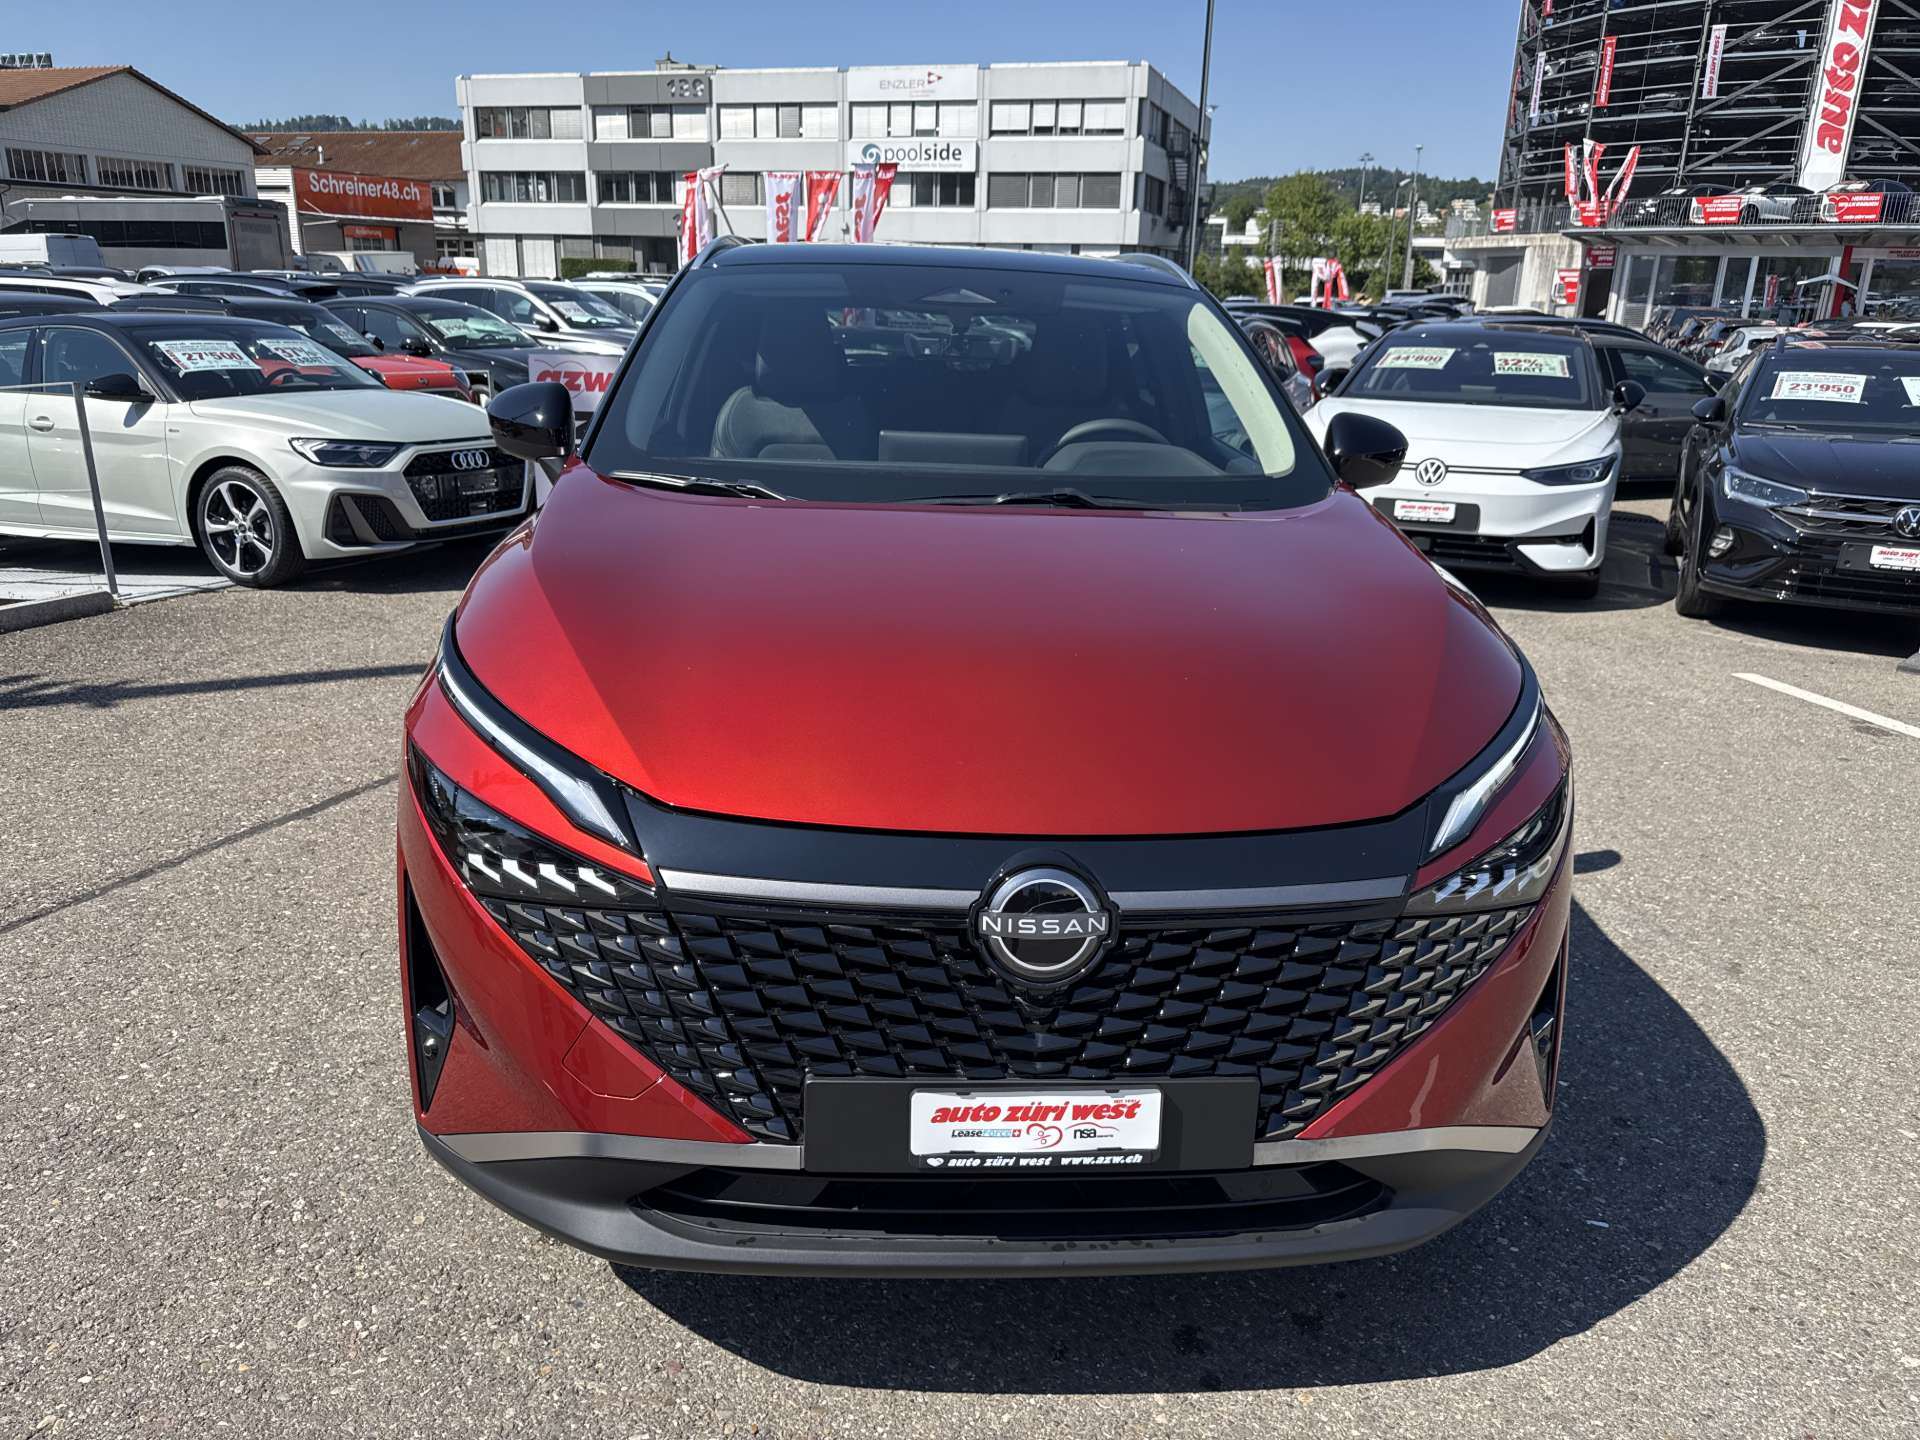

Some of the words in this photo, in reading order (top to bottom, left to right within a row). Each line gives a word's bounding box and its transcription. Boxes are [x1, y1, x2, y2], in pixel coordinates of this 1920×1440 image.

[879, 79, 926, 90] ENZLER
[1817, 42, 1860, 154] auto
[884, 142, 962, 162] poolside
[309, 172, 420, 201] Schreiner48.ch
[182, 351, 245, 361] 27'500
[1497, 358, 1543, 368] 32%
[536, 370, 616, 393] azw
[1788, 382, 1856, 394] 23'950
[982, 915, 1106, 934] NISSAN
[930, 1102, 1001, 1123] auto
[1001, 1101, 1070, 1122] züri
[1071, 1099, 1142, 1120] west
[1073, 1128, 1097, 1139] nsa
[947, 1157, 981, 1167] auto
[983, 1156, 1016, 1167] züri
[1019, 1156, 1053, 1166] west
[1060, 1154, 1143, 1166] www.azw.ch
